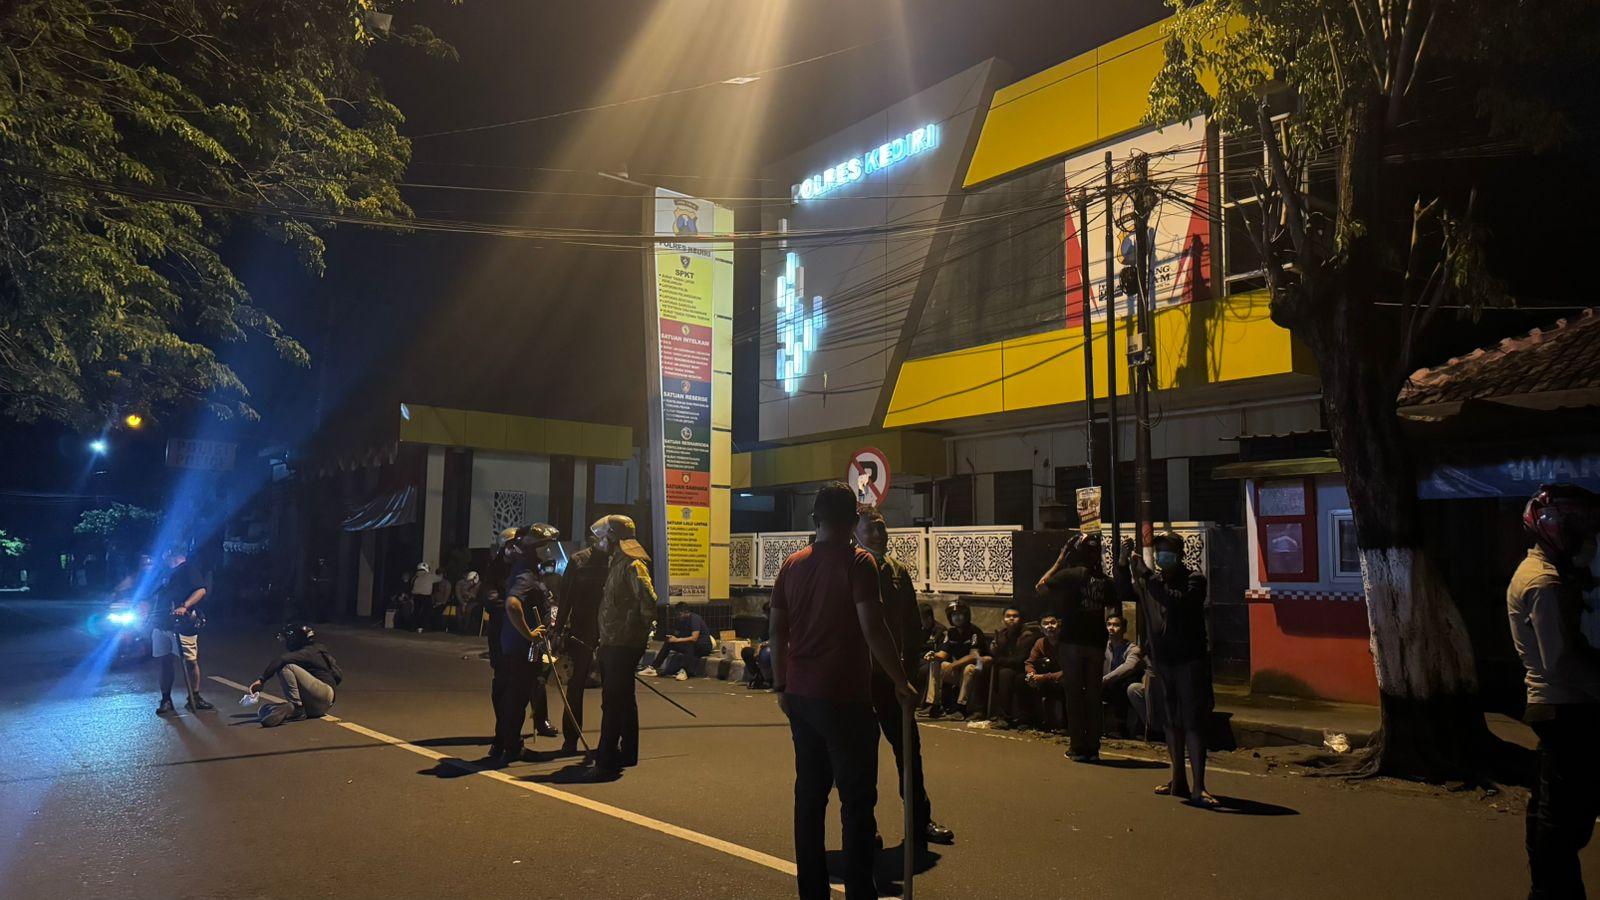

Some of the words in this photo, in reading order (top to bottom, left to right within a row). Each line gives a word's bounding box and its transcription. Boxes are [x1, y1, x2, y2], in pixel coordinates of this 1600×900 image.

[791, 158, 863, 204] POLRES
[864, 123, 938, 174] KEDIRI
[675, 269, 694, 279] SPKT
[661, 332, 682, 343] SATUAN
[664, 391, 684, 399] SATUAN
